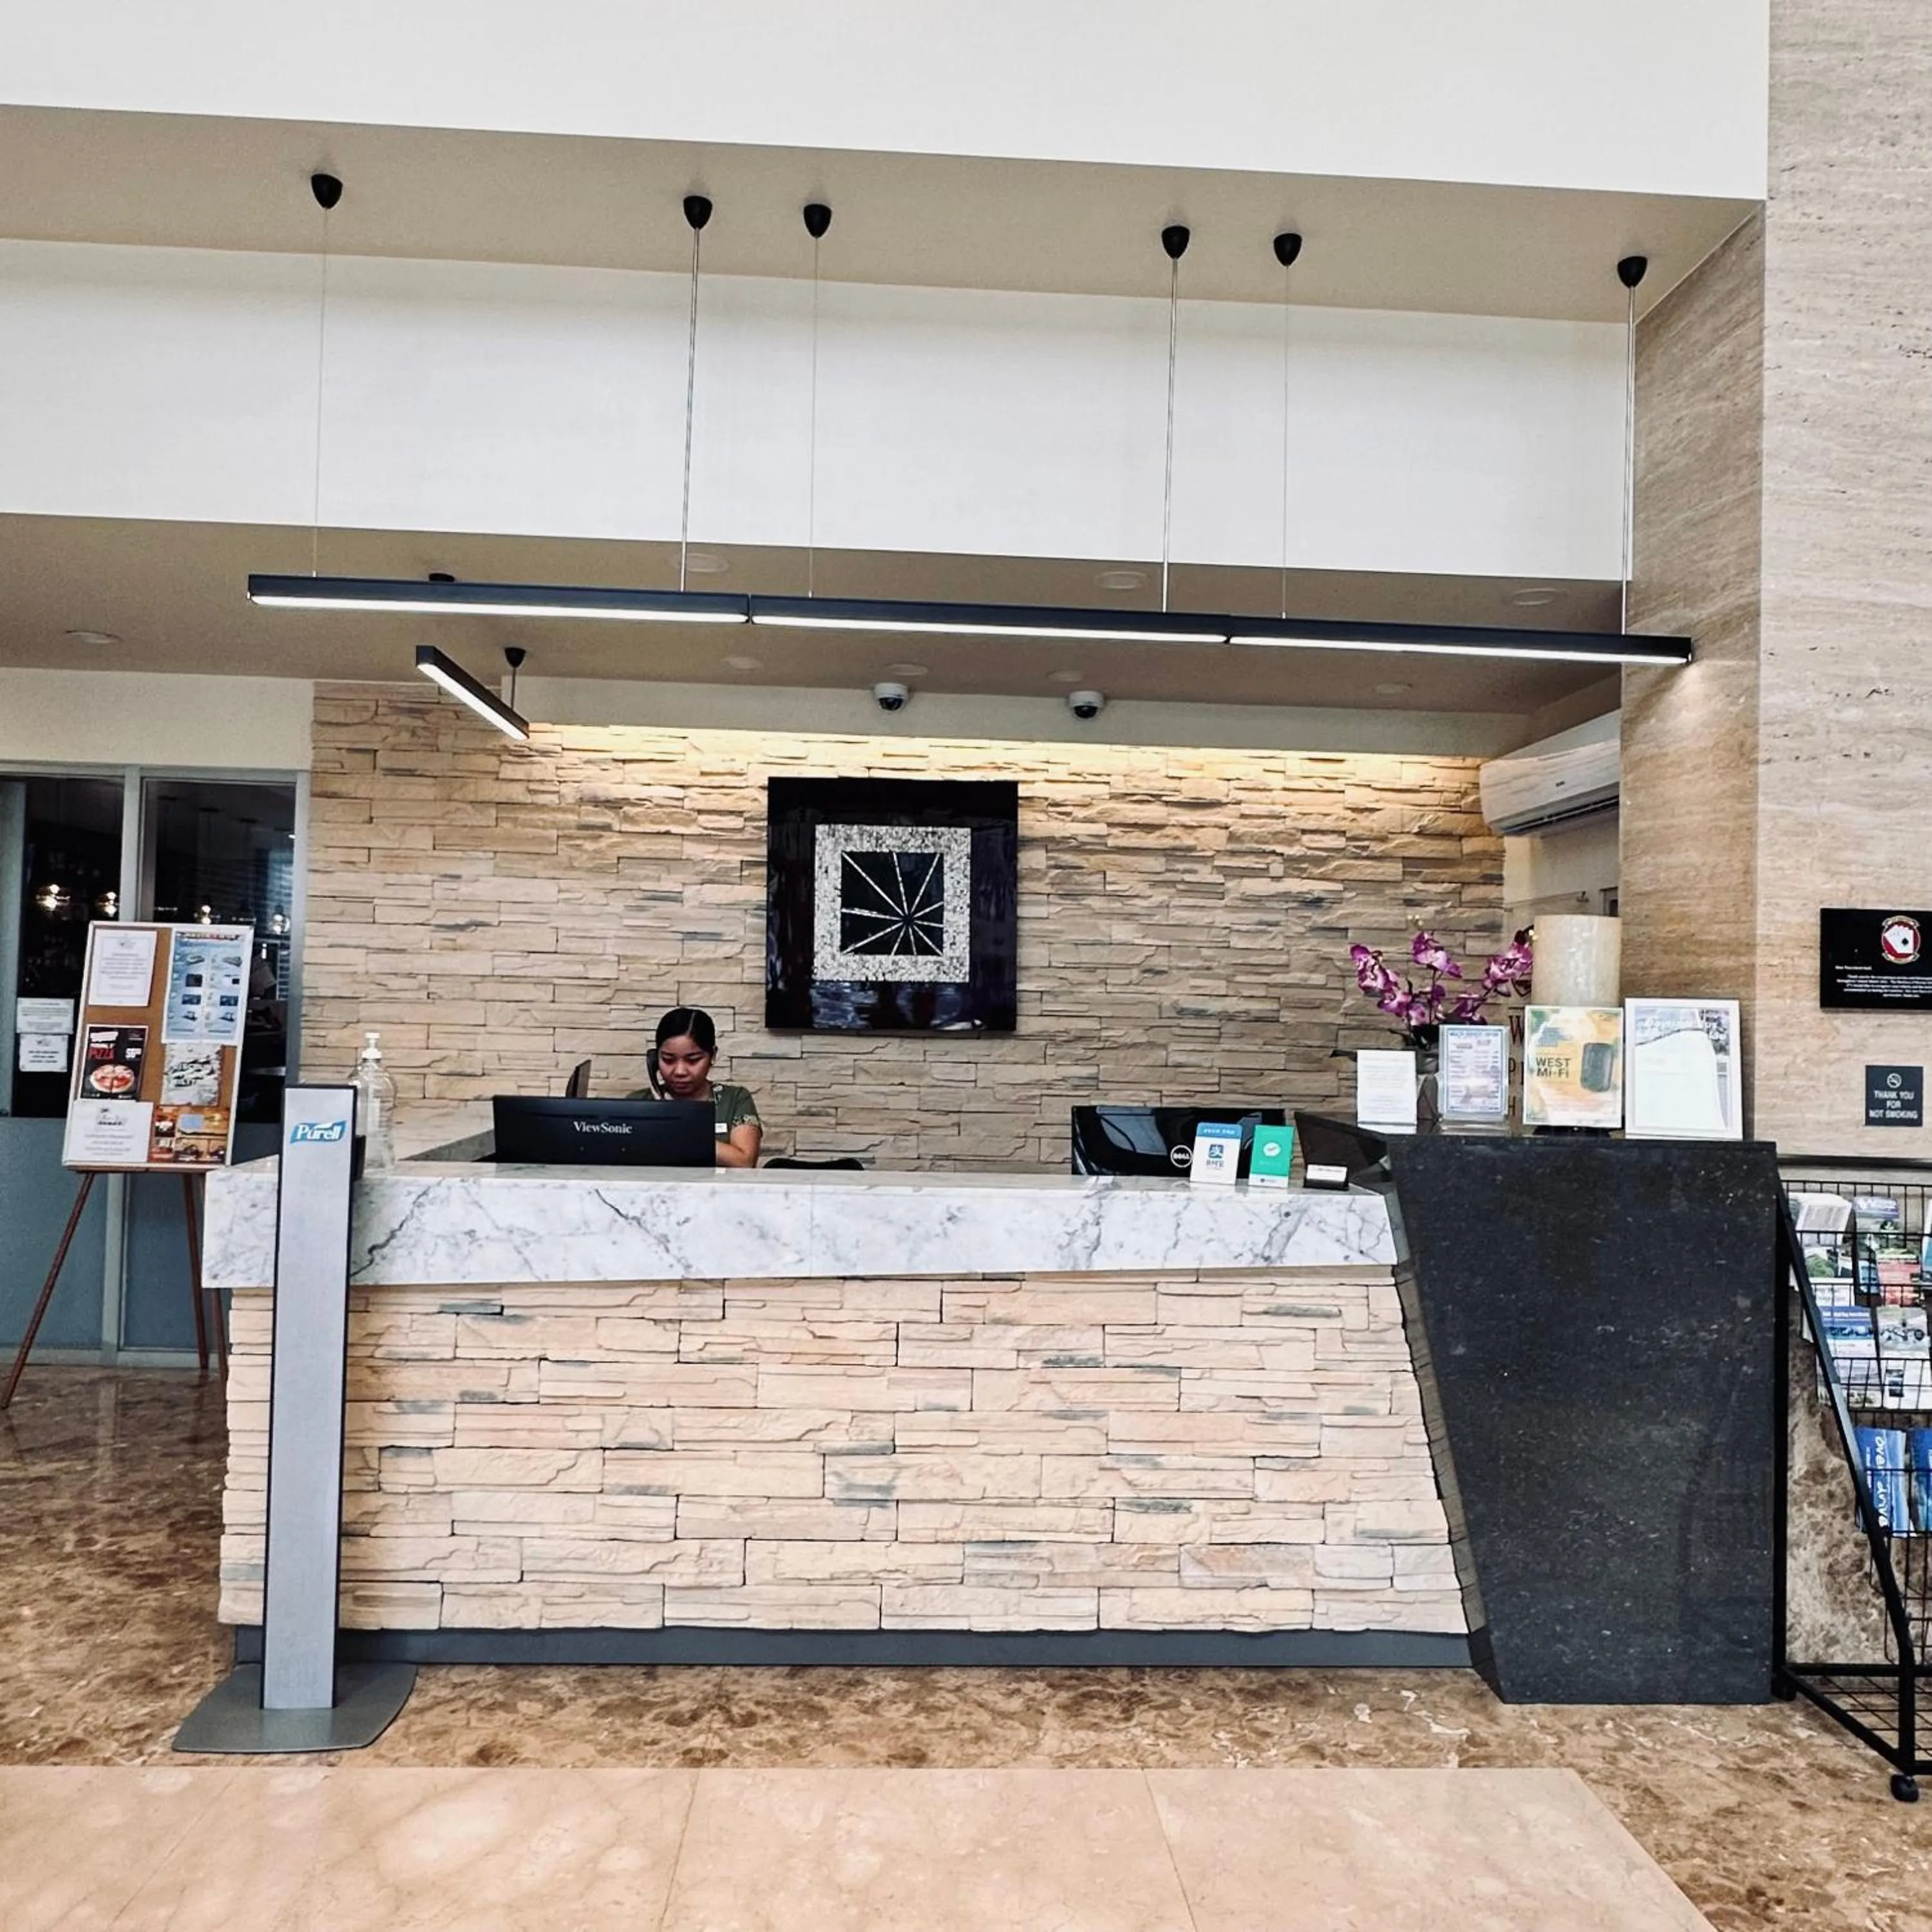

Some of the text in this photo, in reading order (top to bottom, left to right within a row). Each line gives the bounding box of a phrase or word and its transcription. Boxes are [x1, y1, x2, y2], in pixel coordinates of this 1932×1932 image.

[1536, 1057, 1571, 1067] WEST
[1874, 1090, 1915, 1100] THANK YOU
[1886, 1101, 1901, 1109] FOR
[1870, 1110, 1918, 1119] NOT SMOKING
[573, 1121, 632, 1133] ViewSonic
